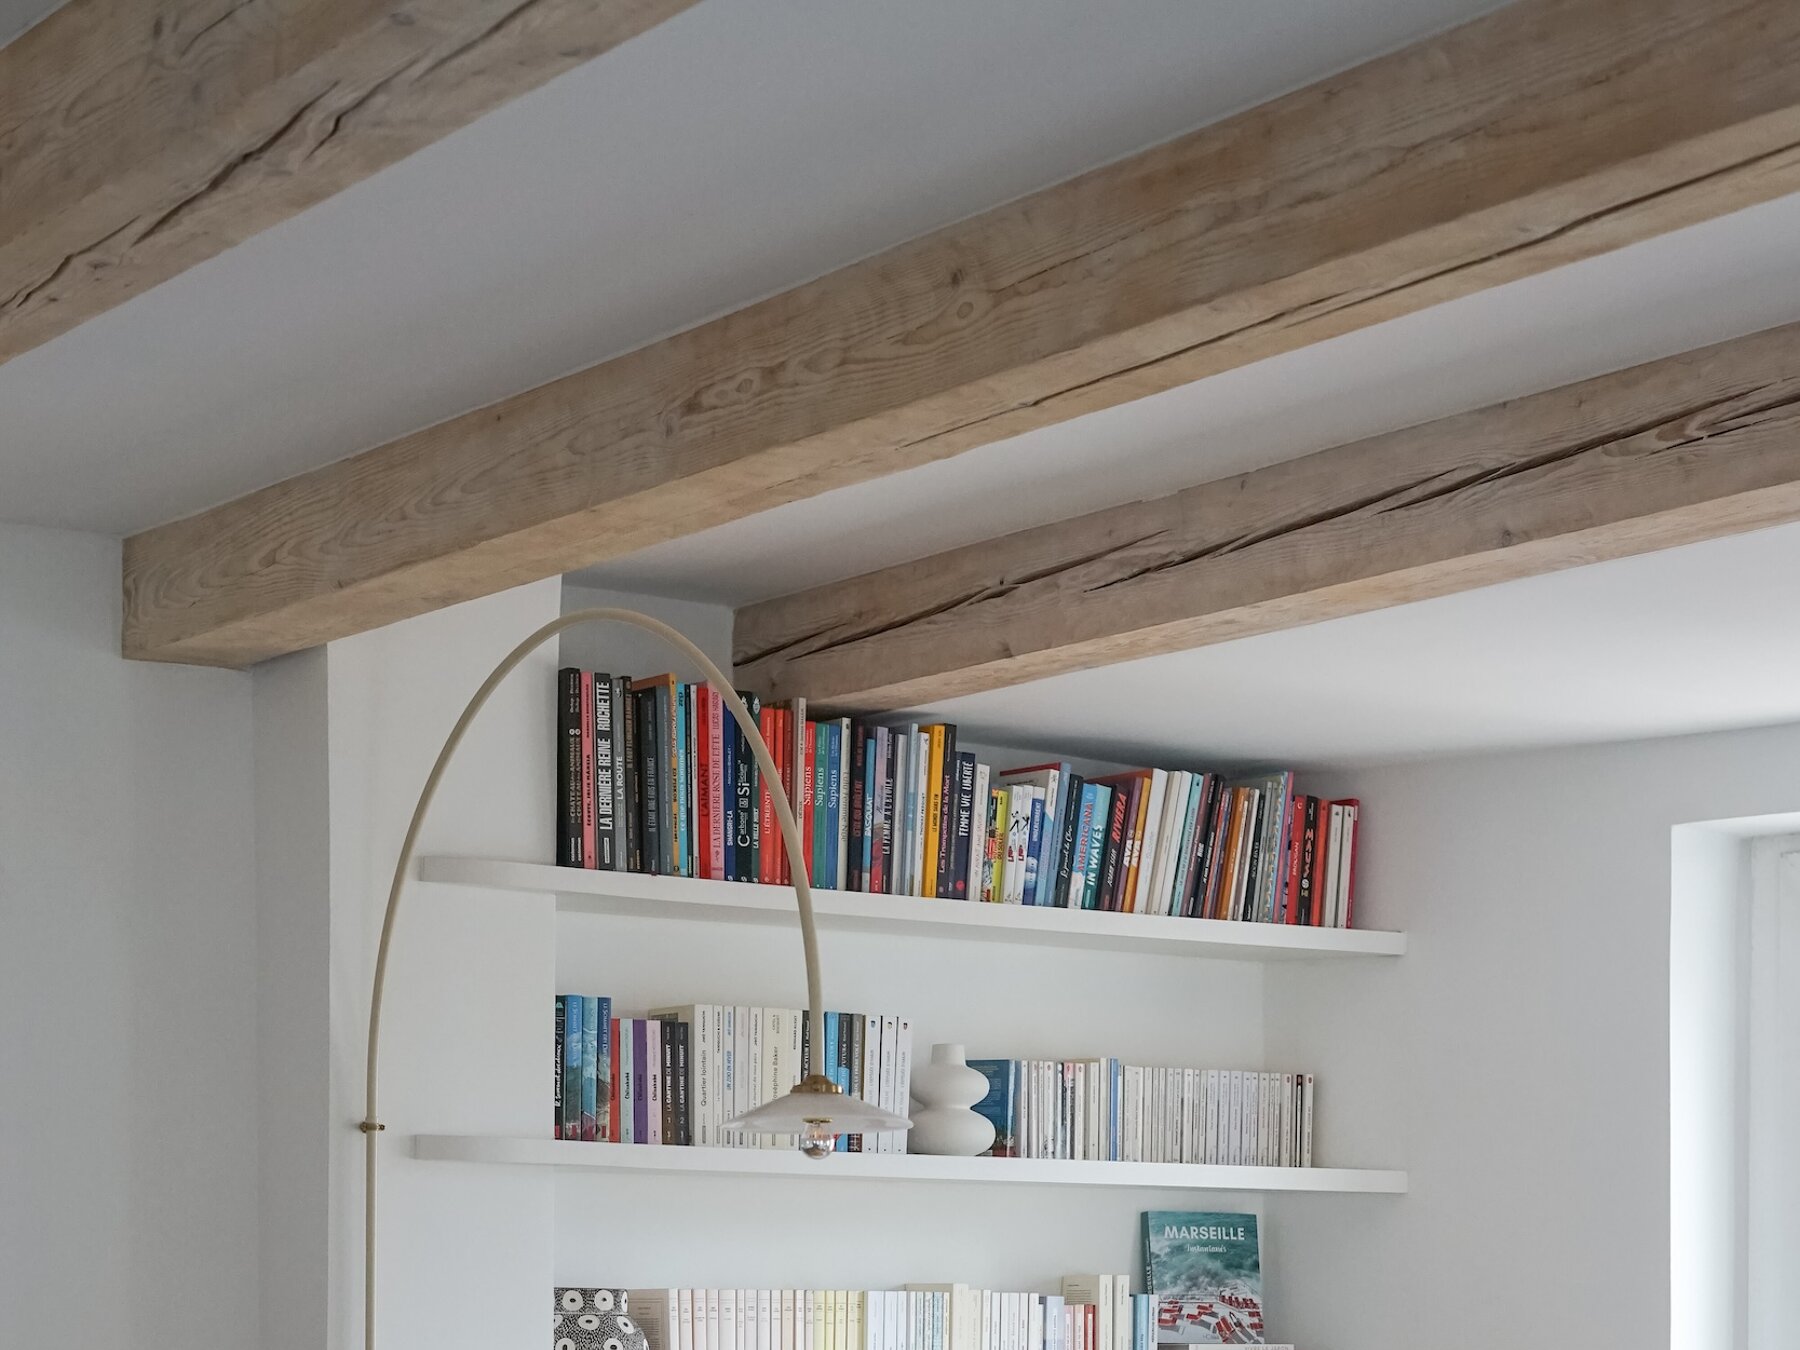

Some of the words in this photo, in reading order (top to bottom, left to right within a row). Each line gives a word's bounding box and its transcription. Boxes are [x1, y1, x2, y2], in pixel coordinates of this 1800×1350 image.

[596, 682, 611, 731] ROCHETTE
[598, 738, 612, 767] REINE
[616, 757, 624, 786] ROUTE
[802, 766, 814, 806] Sapiens
[597, 769, 613, 815] DERNIÈRE
[617, 788, 624, 800] LA
[814, 767, 826, 806] Sapiens
[828, 769, 839, 809] Sapiens
[960, 792, 971, 807] VIE
[599, 817, 613, 830] LA
[958, 809, 971, 837] FEMME
[1112, 792, 1127, 844] RIVIERA
[1077, 802, 1093, 871] AMERICANA
[1089, 824, 1104, 869] WAVES
[1123, 840, 1133, 867] AVA
[1132, 840, 1142, 868] AVA
[1086, 872, 1097, 886] IN
[1163, 1226, 1246, 1241] MARSEILLE
